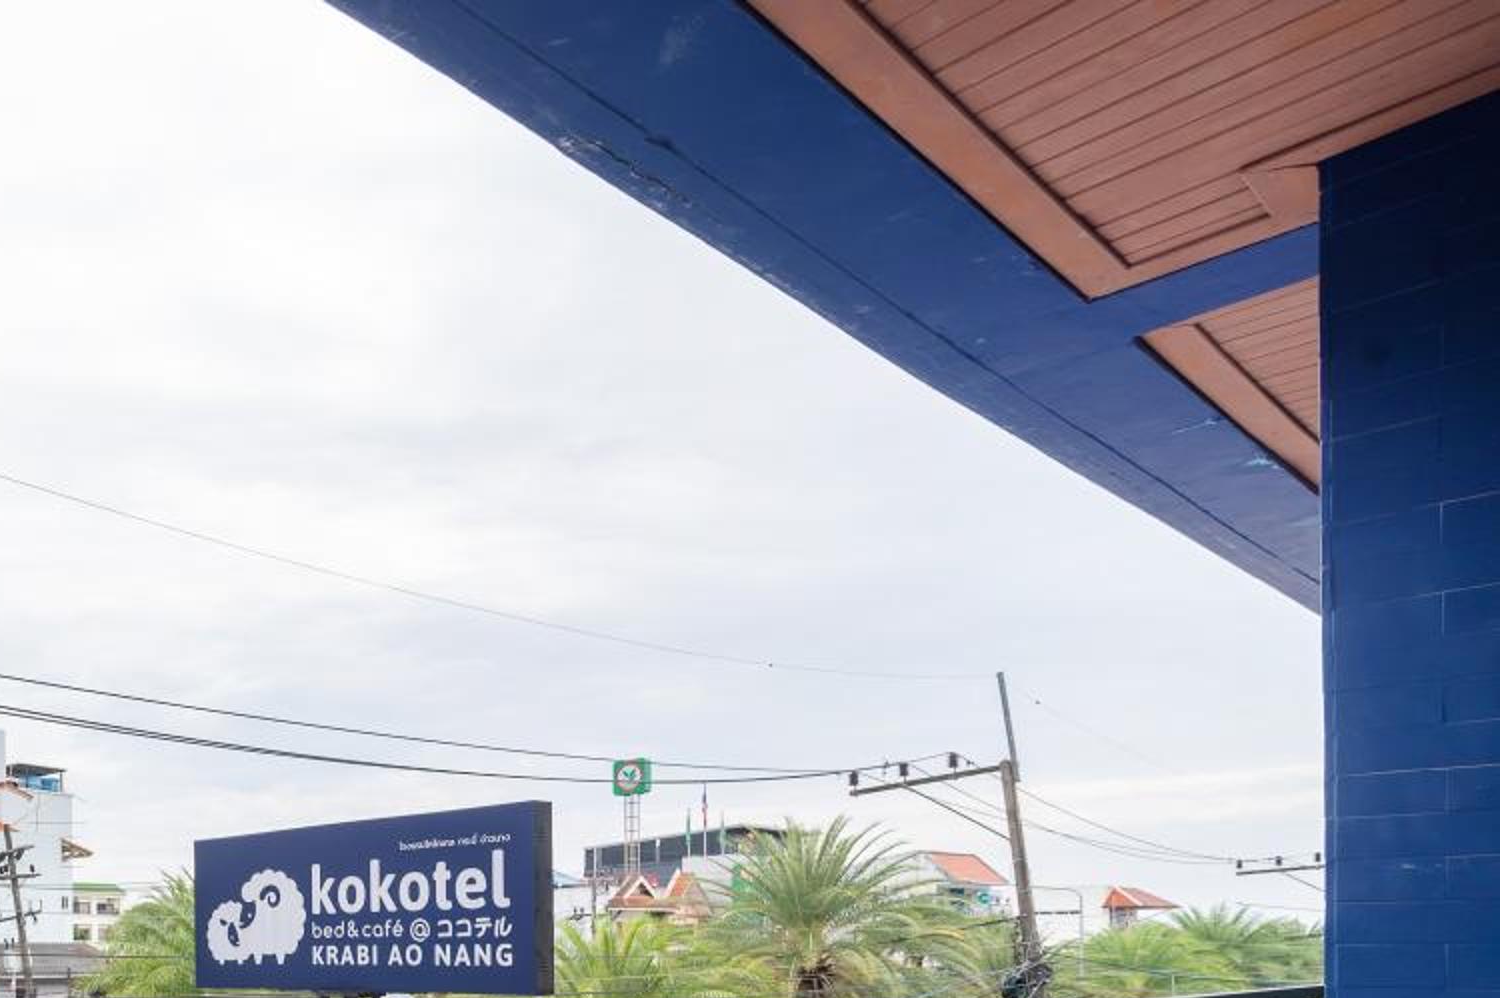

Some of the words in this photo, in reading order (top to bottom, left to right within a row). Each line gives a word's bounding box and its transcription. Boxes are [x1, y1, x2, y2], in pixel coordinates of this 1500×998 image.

[311, 848, 511, 915] kokotel
[409, 917, 431, 942] @
[437, 917, 513, 938] ココテル
[311, 944, 379, 966] KRABI
[387, 944, 423, 967] AO
[434, 943, 514, 967] NANG
